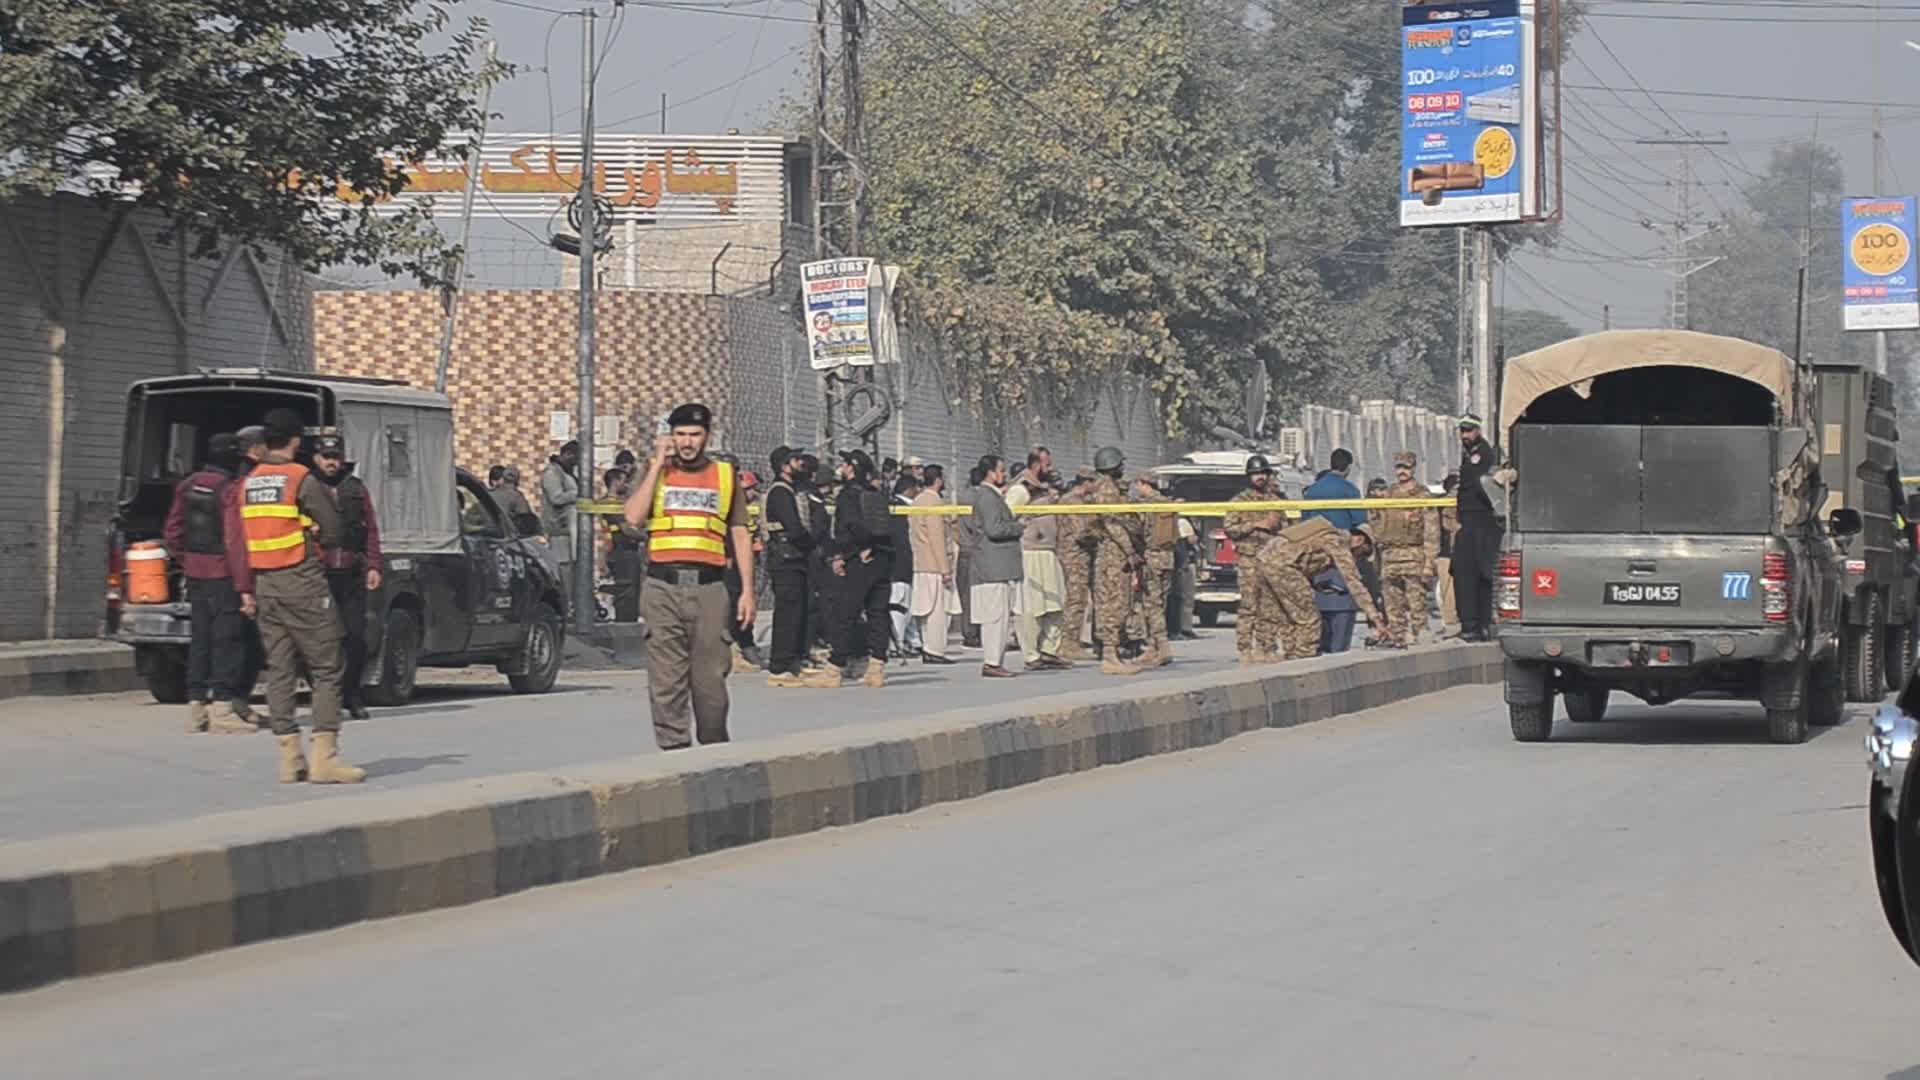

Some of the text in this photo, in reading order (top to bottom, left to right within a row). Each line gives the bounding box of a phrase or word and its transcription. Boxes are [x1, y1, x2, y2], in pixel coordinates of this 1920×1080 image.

[1408, 68, 1434, 85] 100
[1497, 64, 1514, 76] 40
[1445, 95, 1459, 107] 10
[1862, 233, 1898, 249] 100
[1723, 575, 1750, 598] 777
